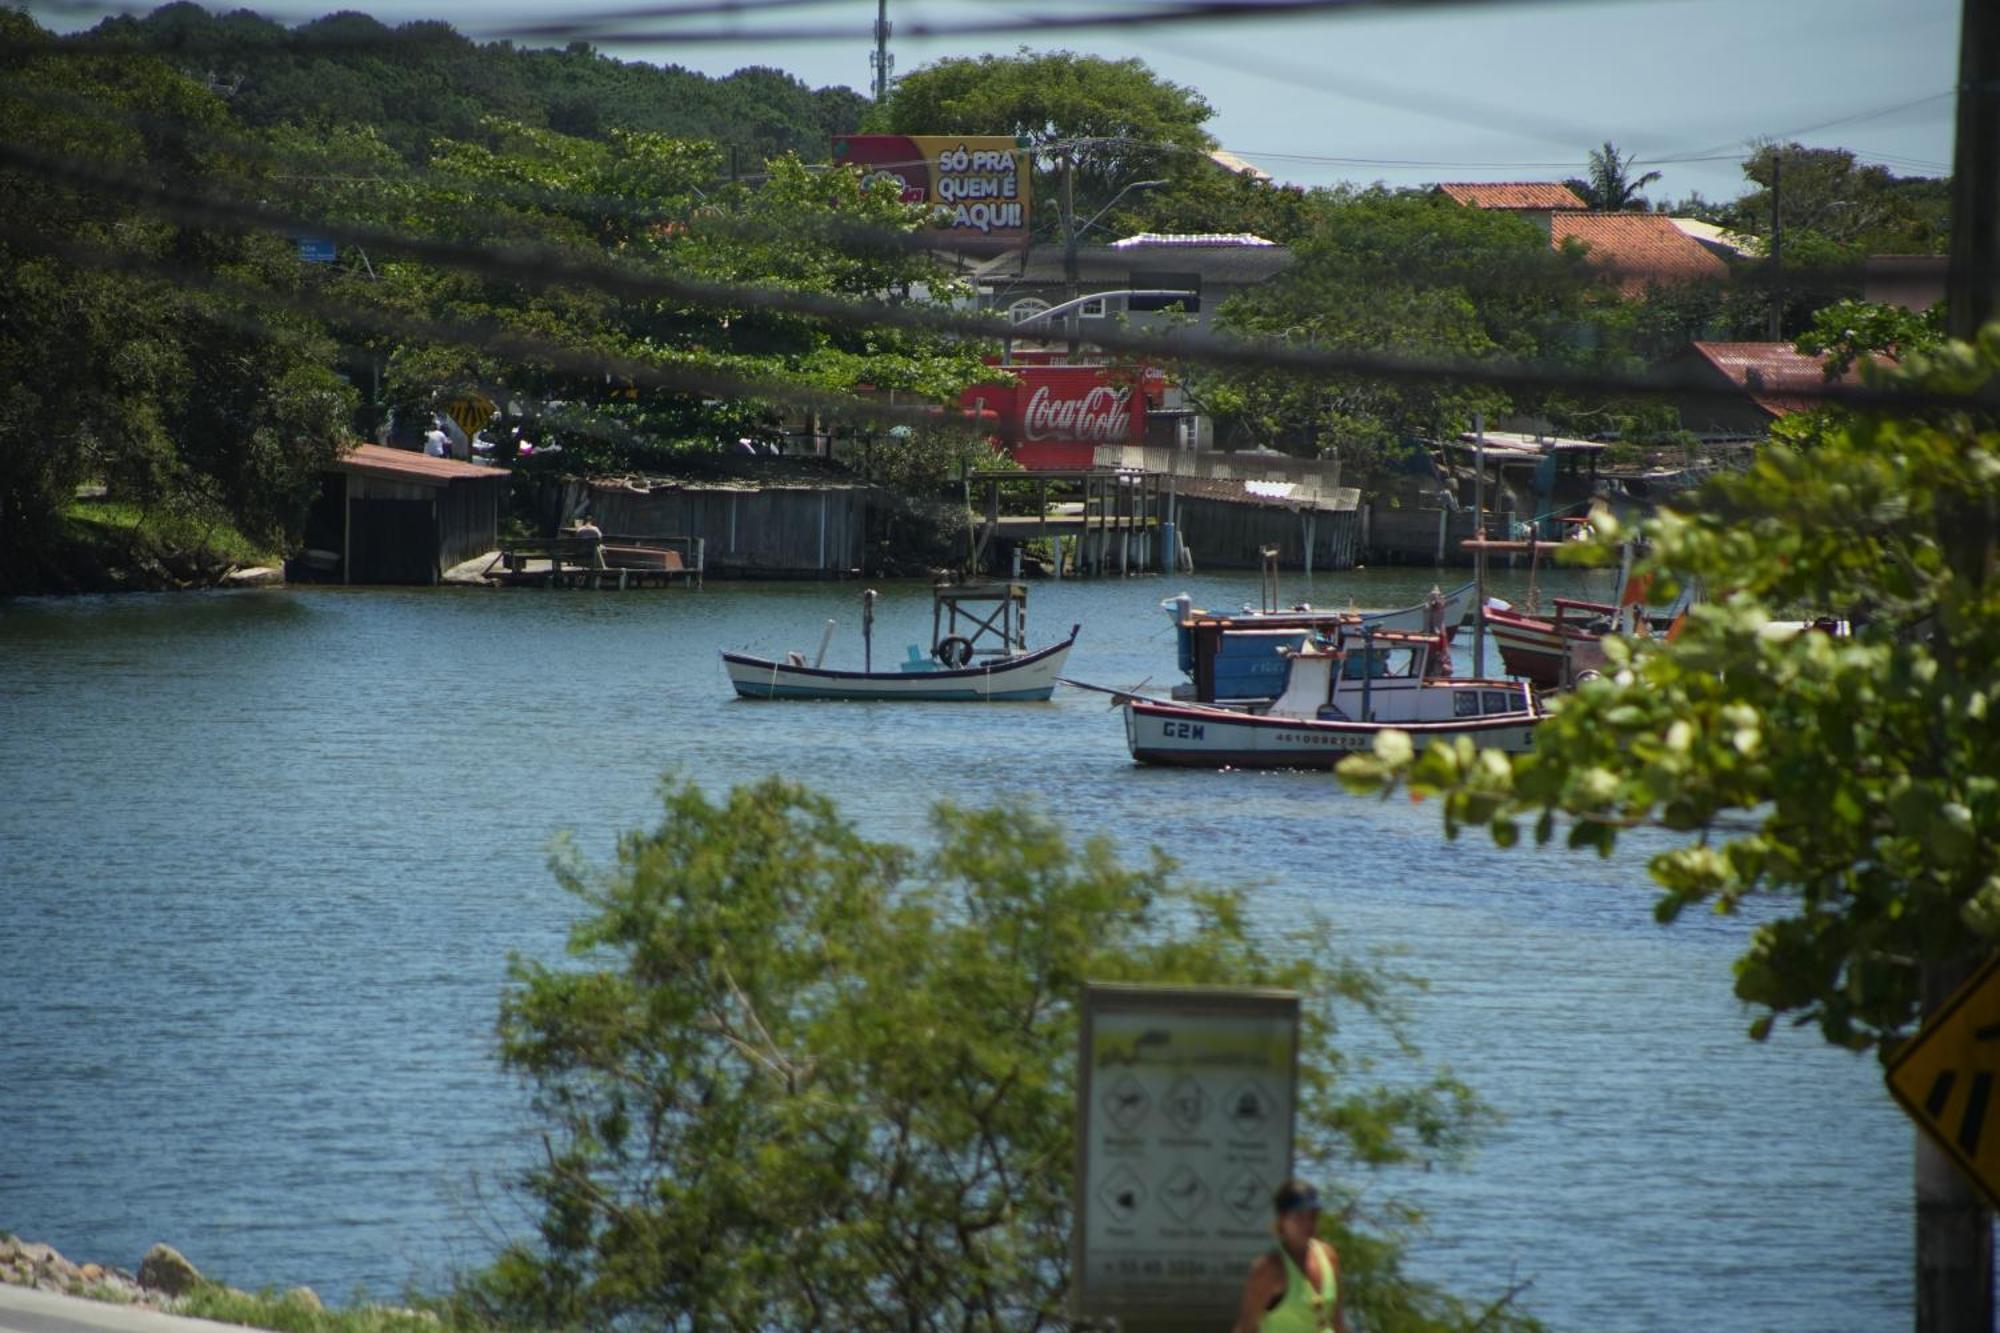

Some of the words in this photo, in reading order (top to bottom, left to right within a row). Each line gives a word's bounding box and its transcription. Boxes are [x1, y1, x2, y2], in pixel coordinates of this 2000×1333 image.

[939, 145, 969, 172] SÓ
[972, 150, 1016, 172] PRA
[938, 176, 999, 202] QUEM
[1002, 171, 1018, 198] É
[1024, 386, 1132, 441] Coca-Cola
